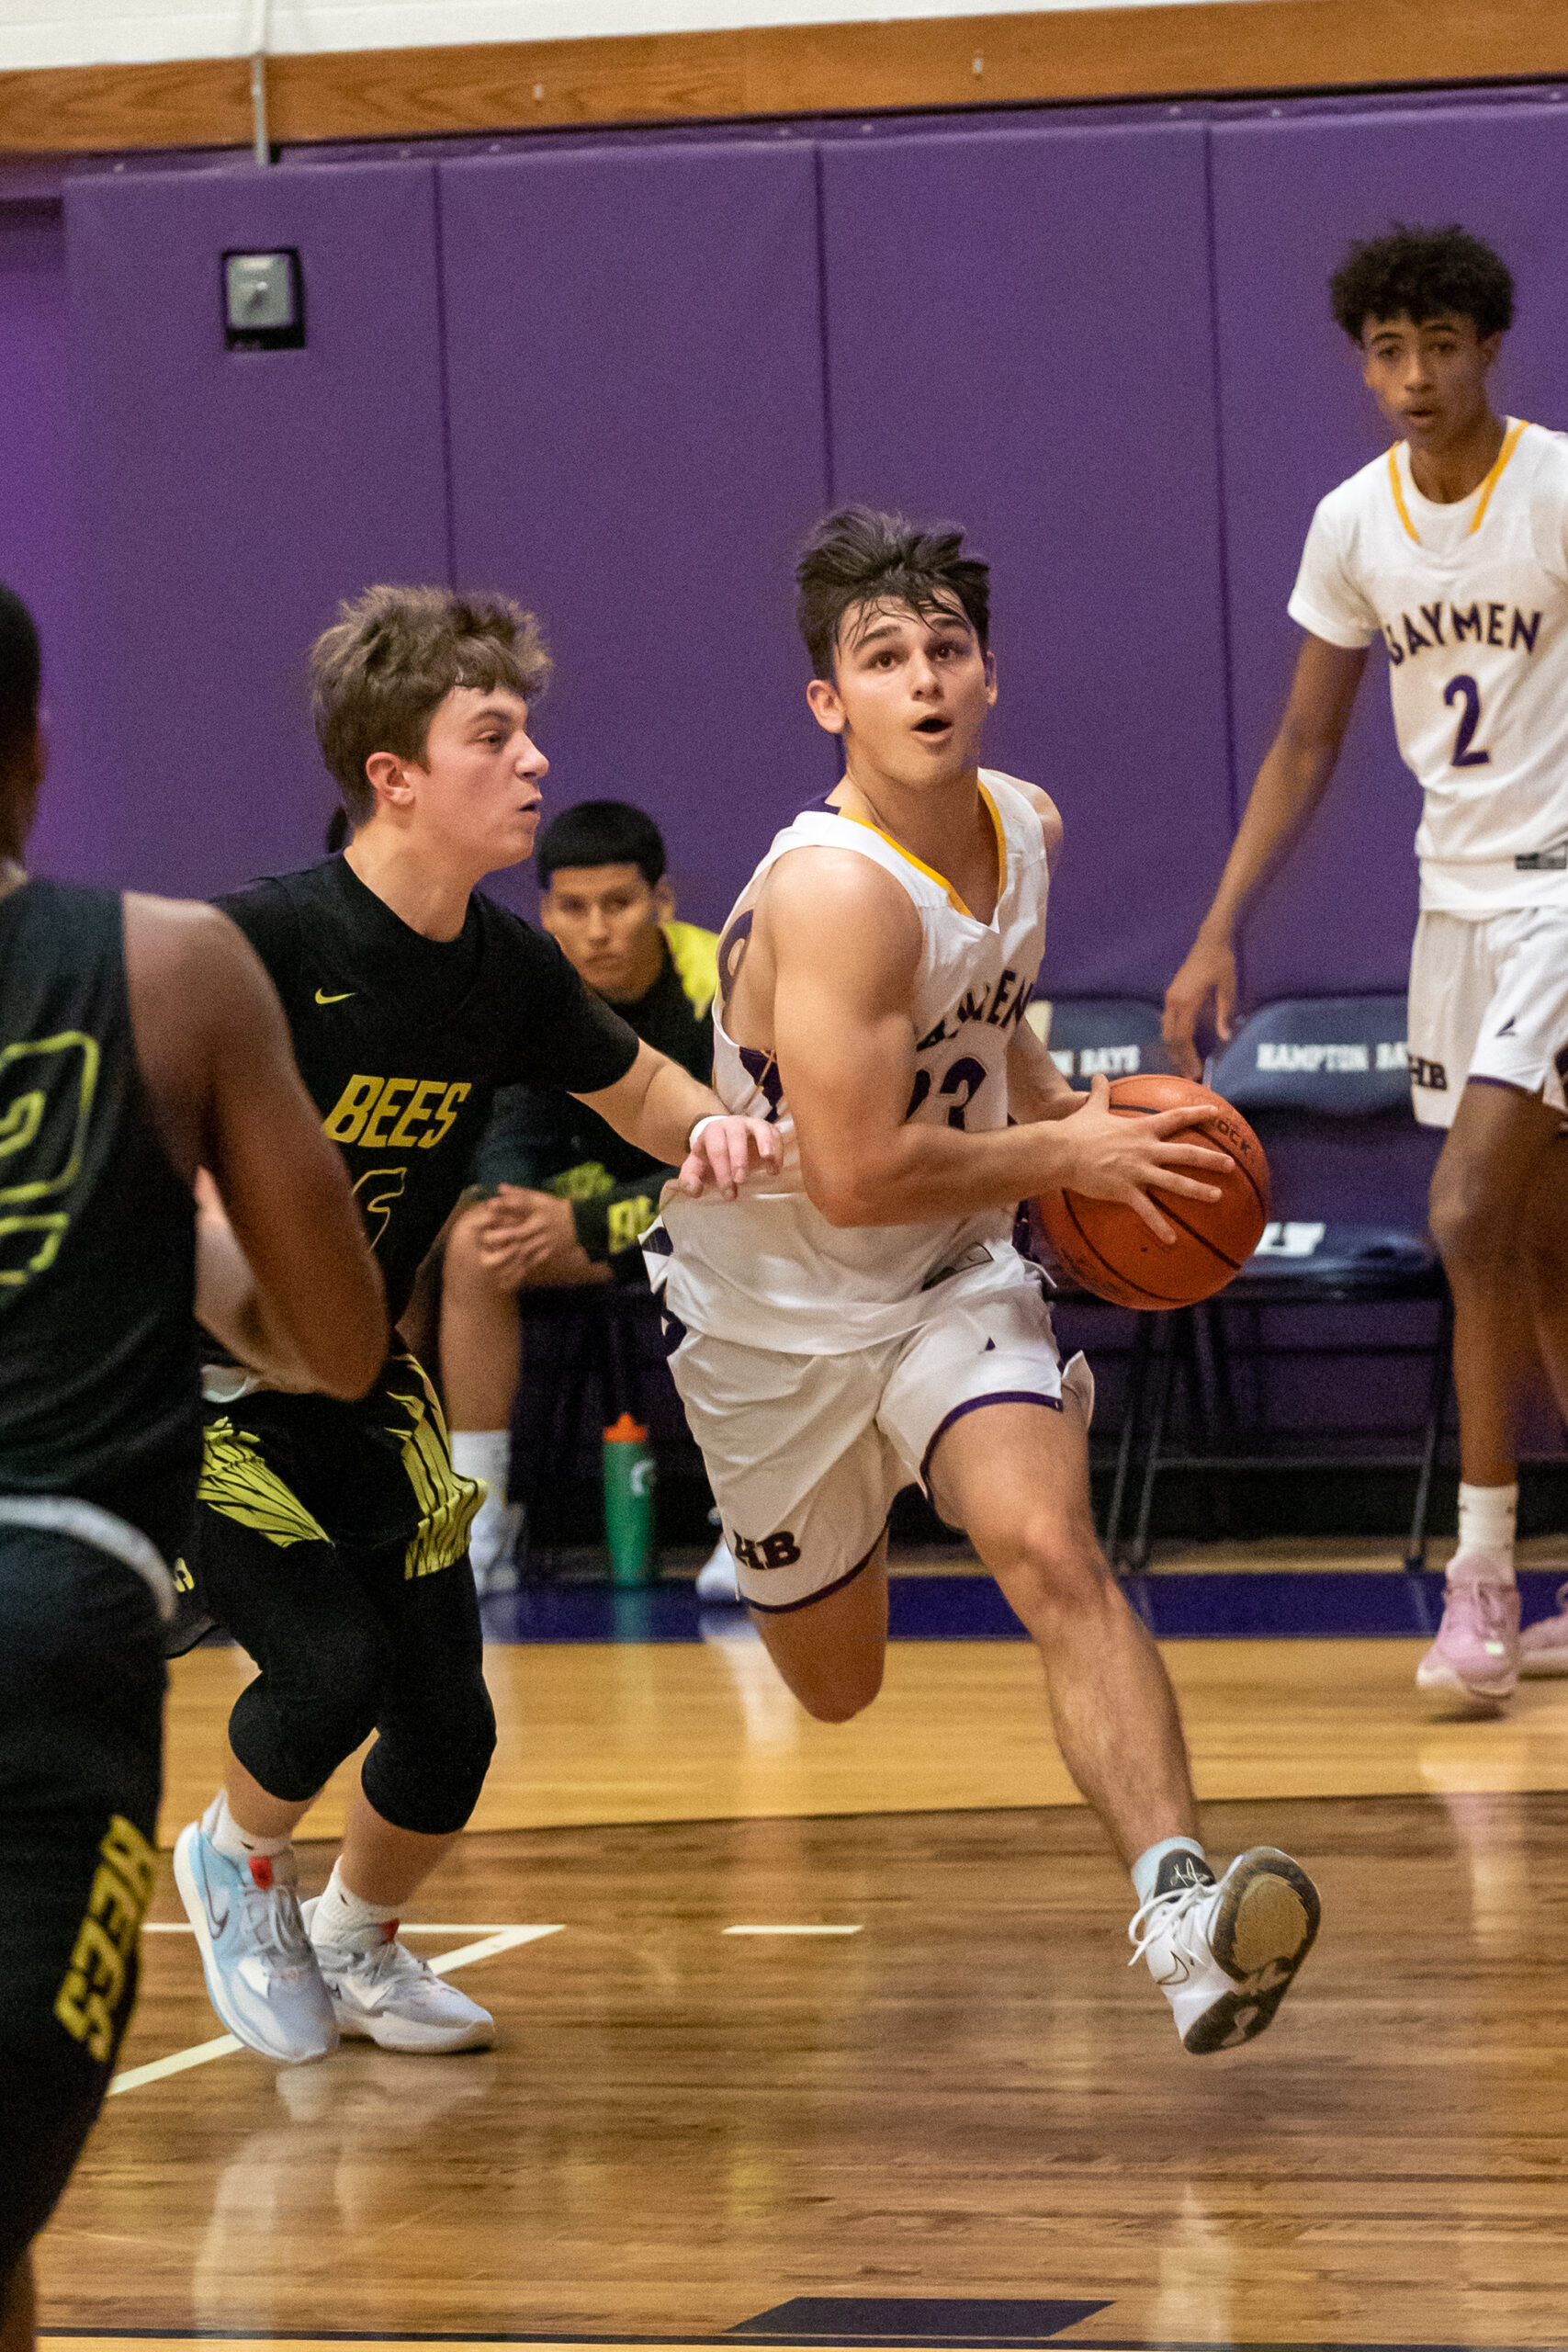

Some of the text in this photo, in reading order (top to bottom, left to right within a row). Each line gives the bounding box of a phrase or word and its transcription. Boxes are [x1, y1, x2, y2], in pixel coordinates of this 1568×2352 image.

[1444, 673, 1489, 766] 2
[322, 1074, 472, 1149] BEES
[1213, 1117, 1252, 1156] OCK
[732, 1529, 802, 1570] HB
